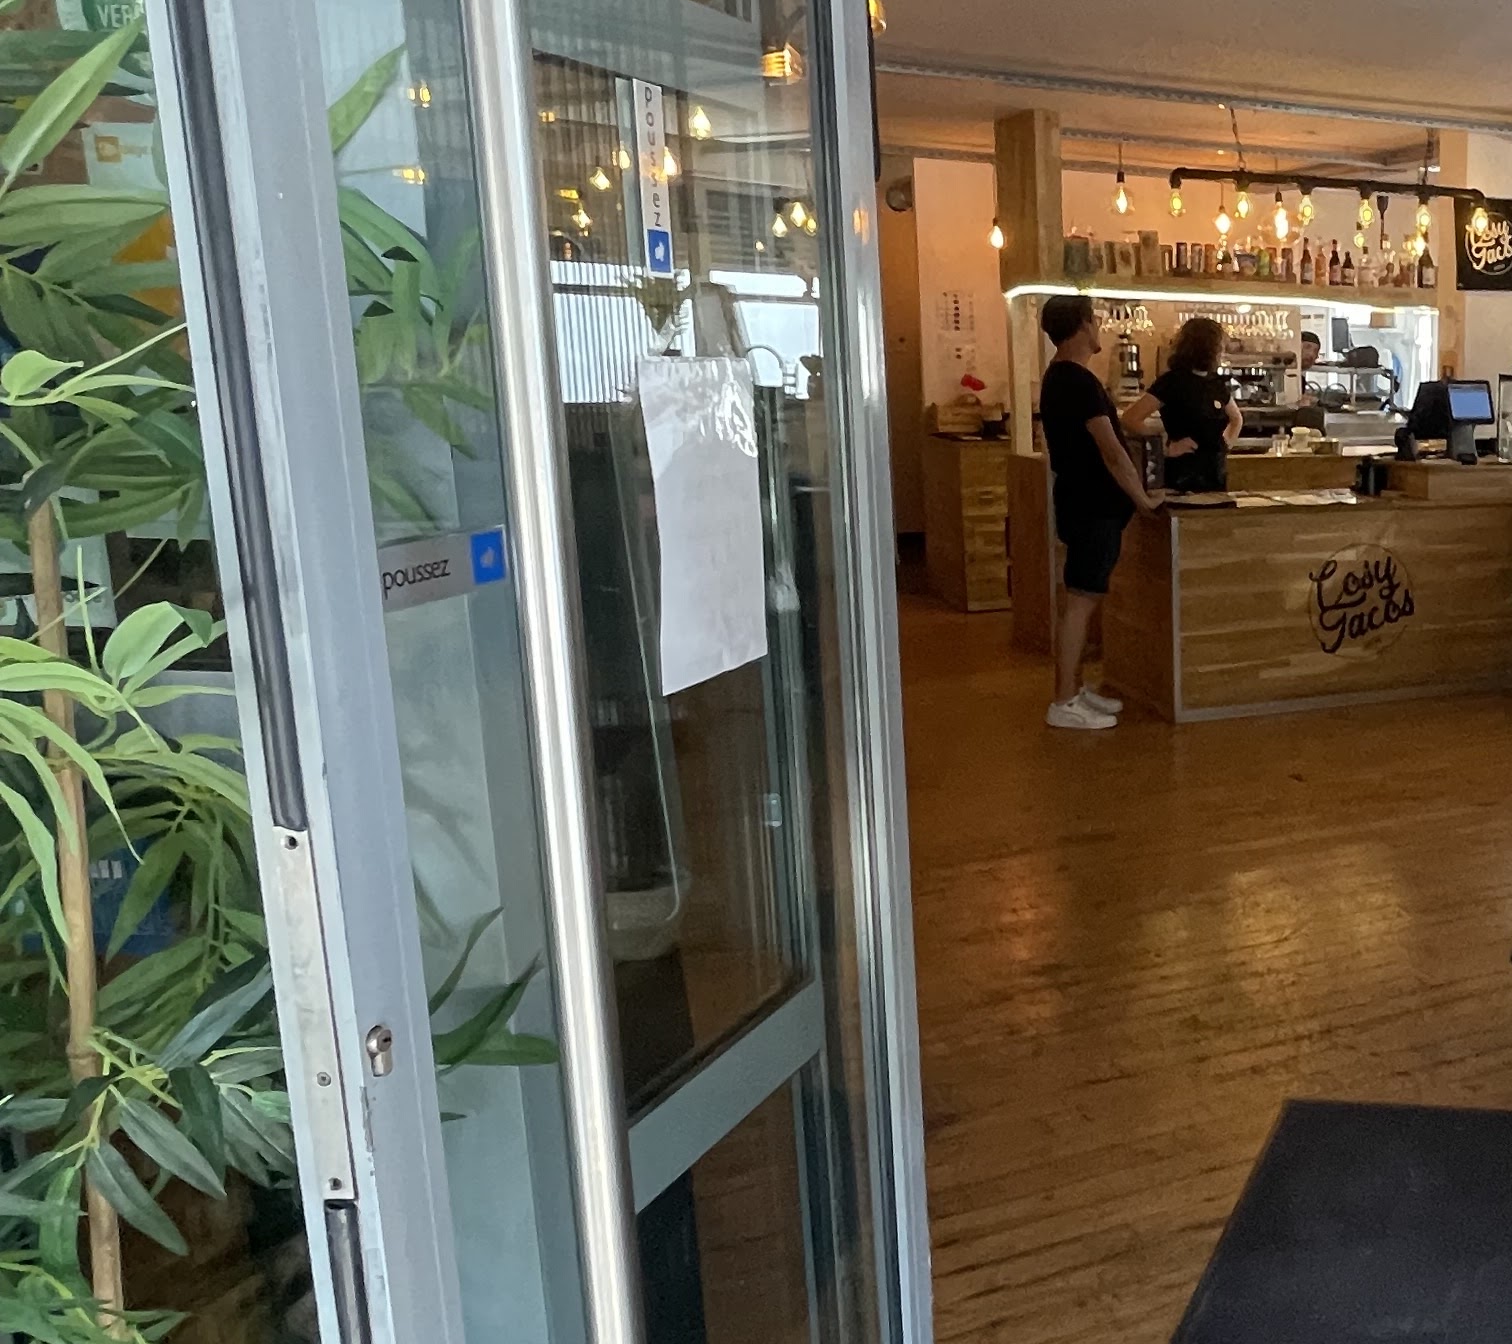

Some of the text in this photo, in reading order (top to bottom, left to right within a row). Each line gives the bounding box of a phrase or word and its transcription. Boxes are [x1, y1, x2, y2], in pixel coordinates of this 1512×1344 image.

[96, 3, 144, 28] VER
[382, 559, 451, 600] poussez
[1309, 556, 1401, 612] Cosy
[1319, 588, 1415, 654] Tacos
